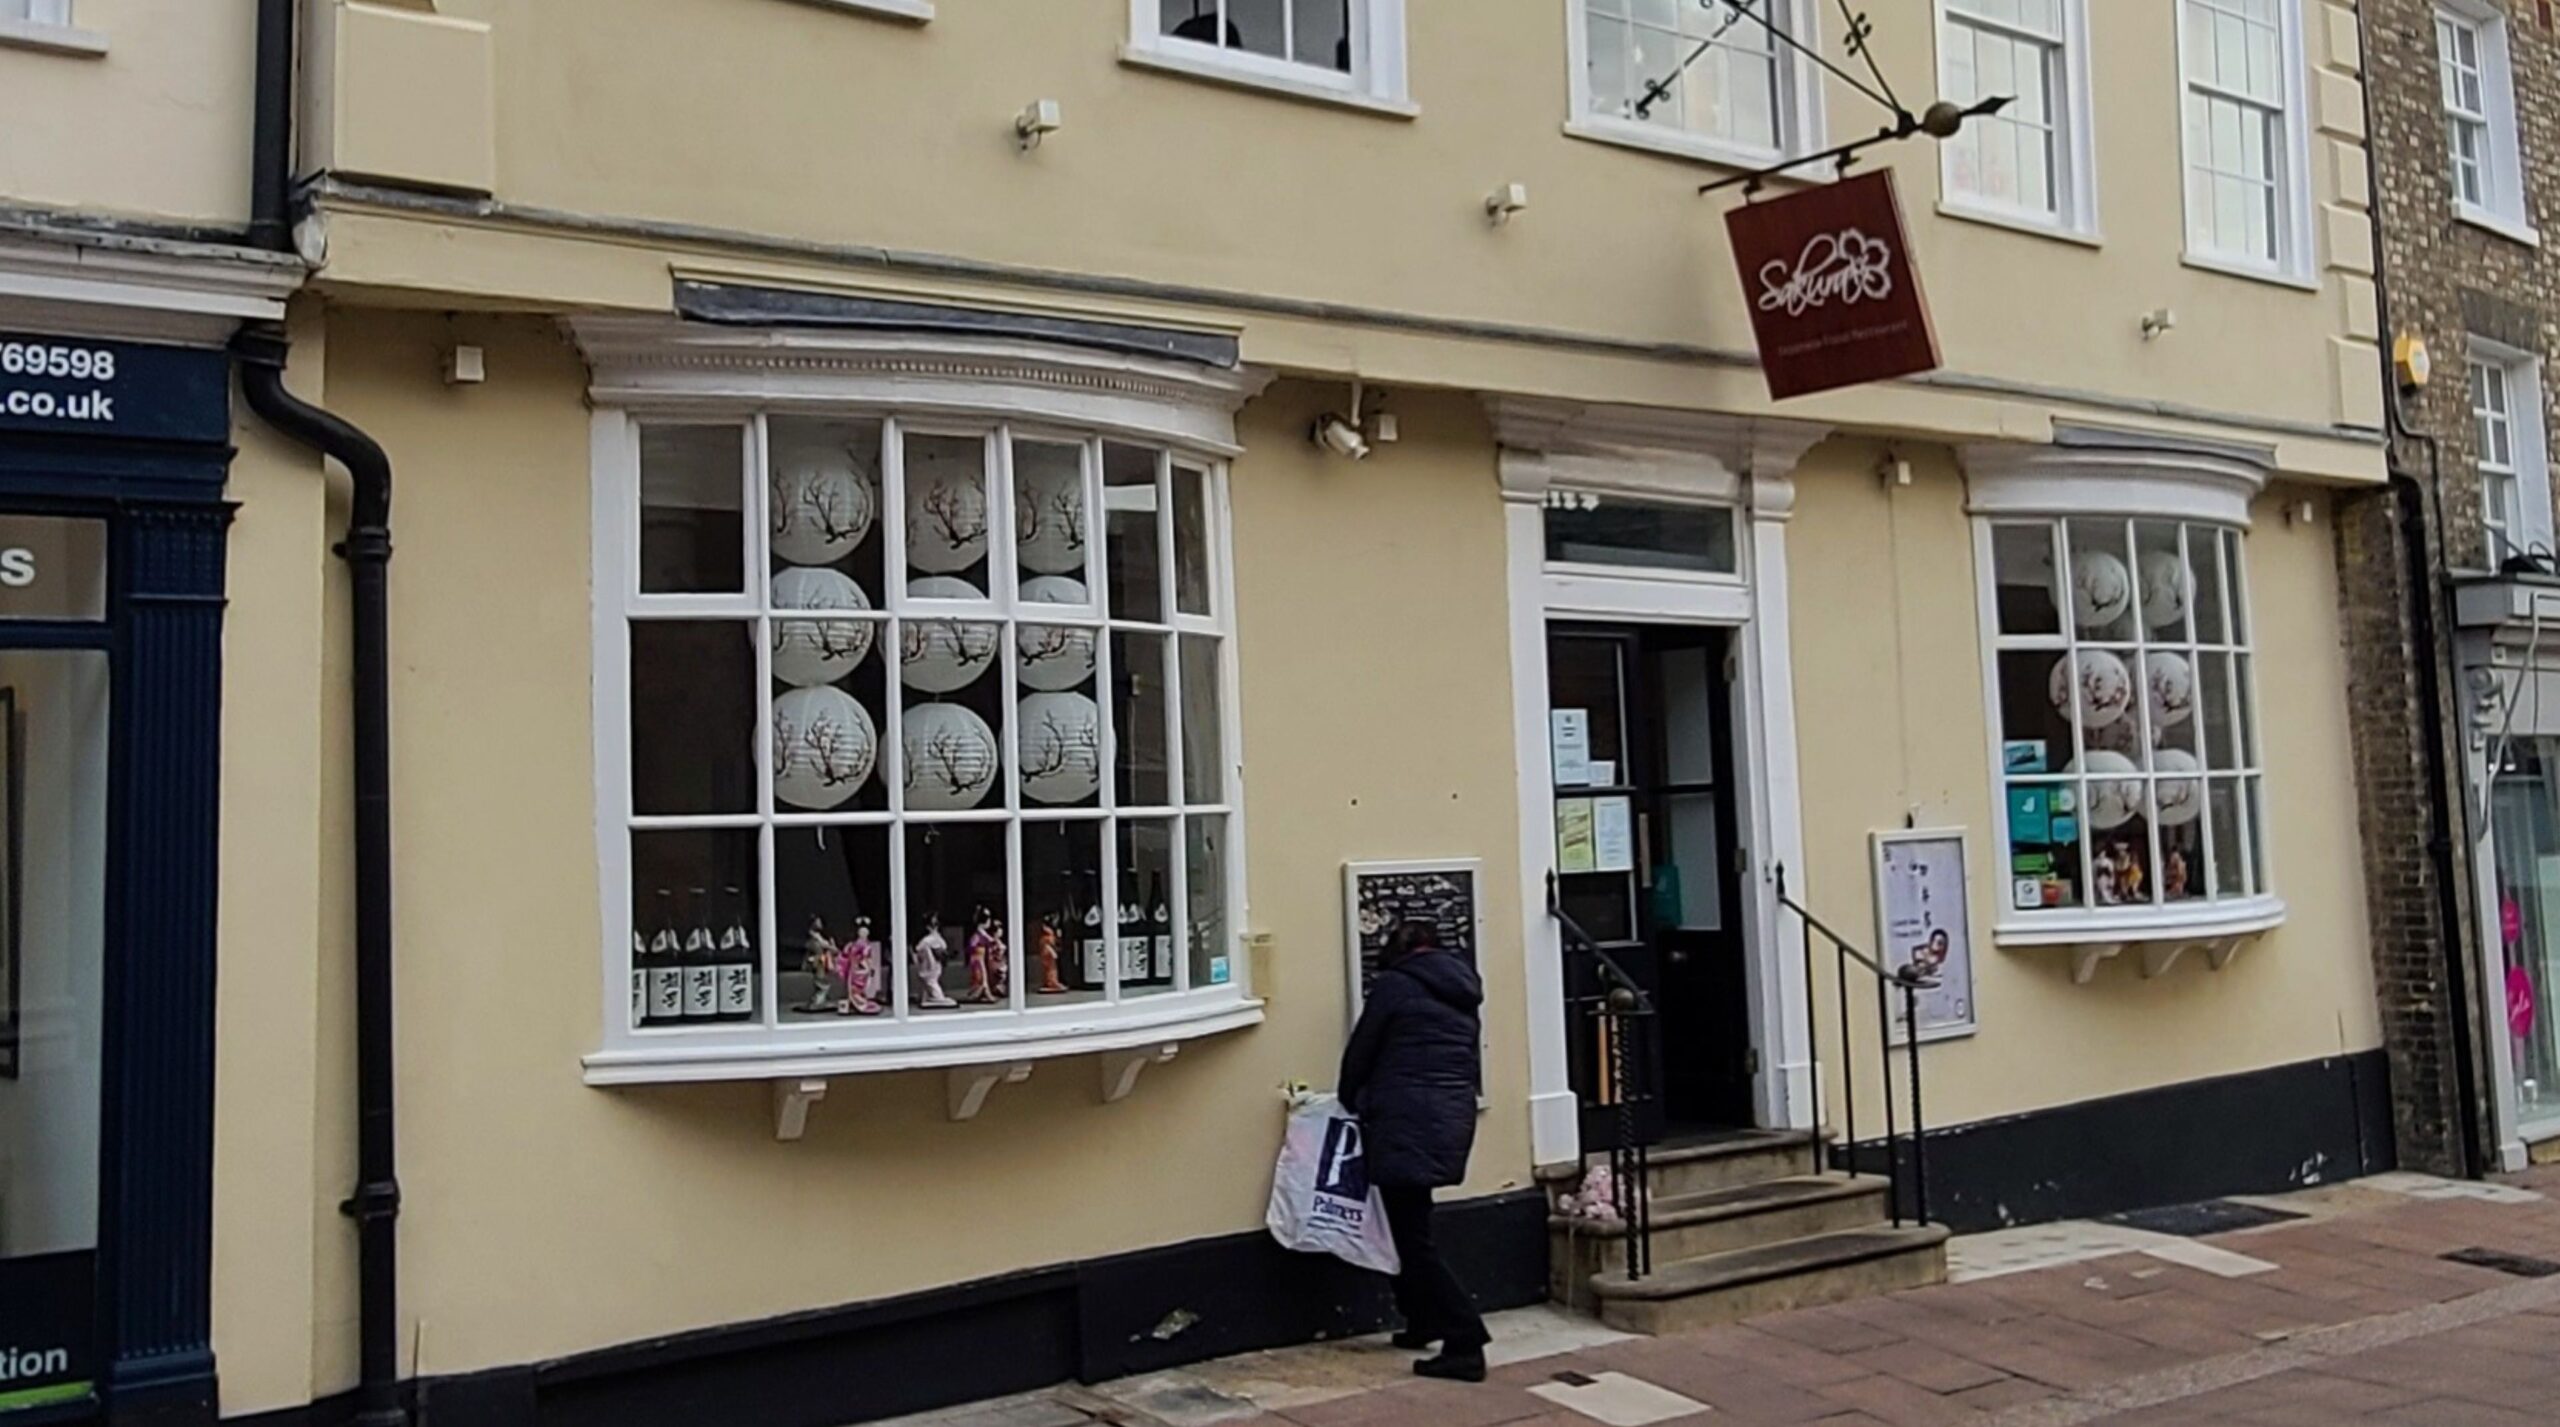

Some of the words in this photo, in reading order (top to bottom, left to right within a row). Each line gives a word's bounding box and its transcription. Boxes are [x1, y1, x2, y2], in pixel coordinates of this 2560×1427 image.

[0, 342, 115, 381] 69598
[0, 389, 114, 421] .co.uk
[1326, 1120, 1363, 1187] P
[1312, 1194, 1364, 1222] Palmers
[0, 1346, 68, 1380] tion
